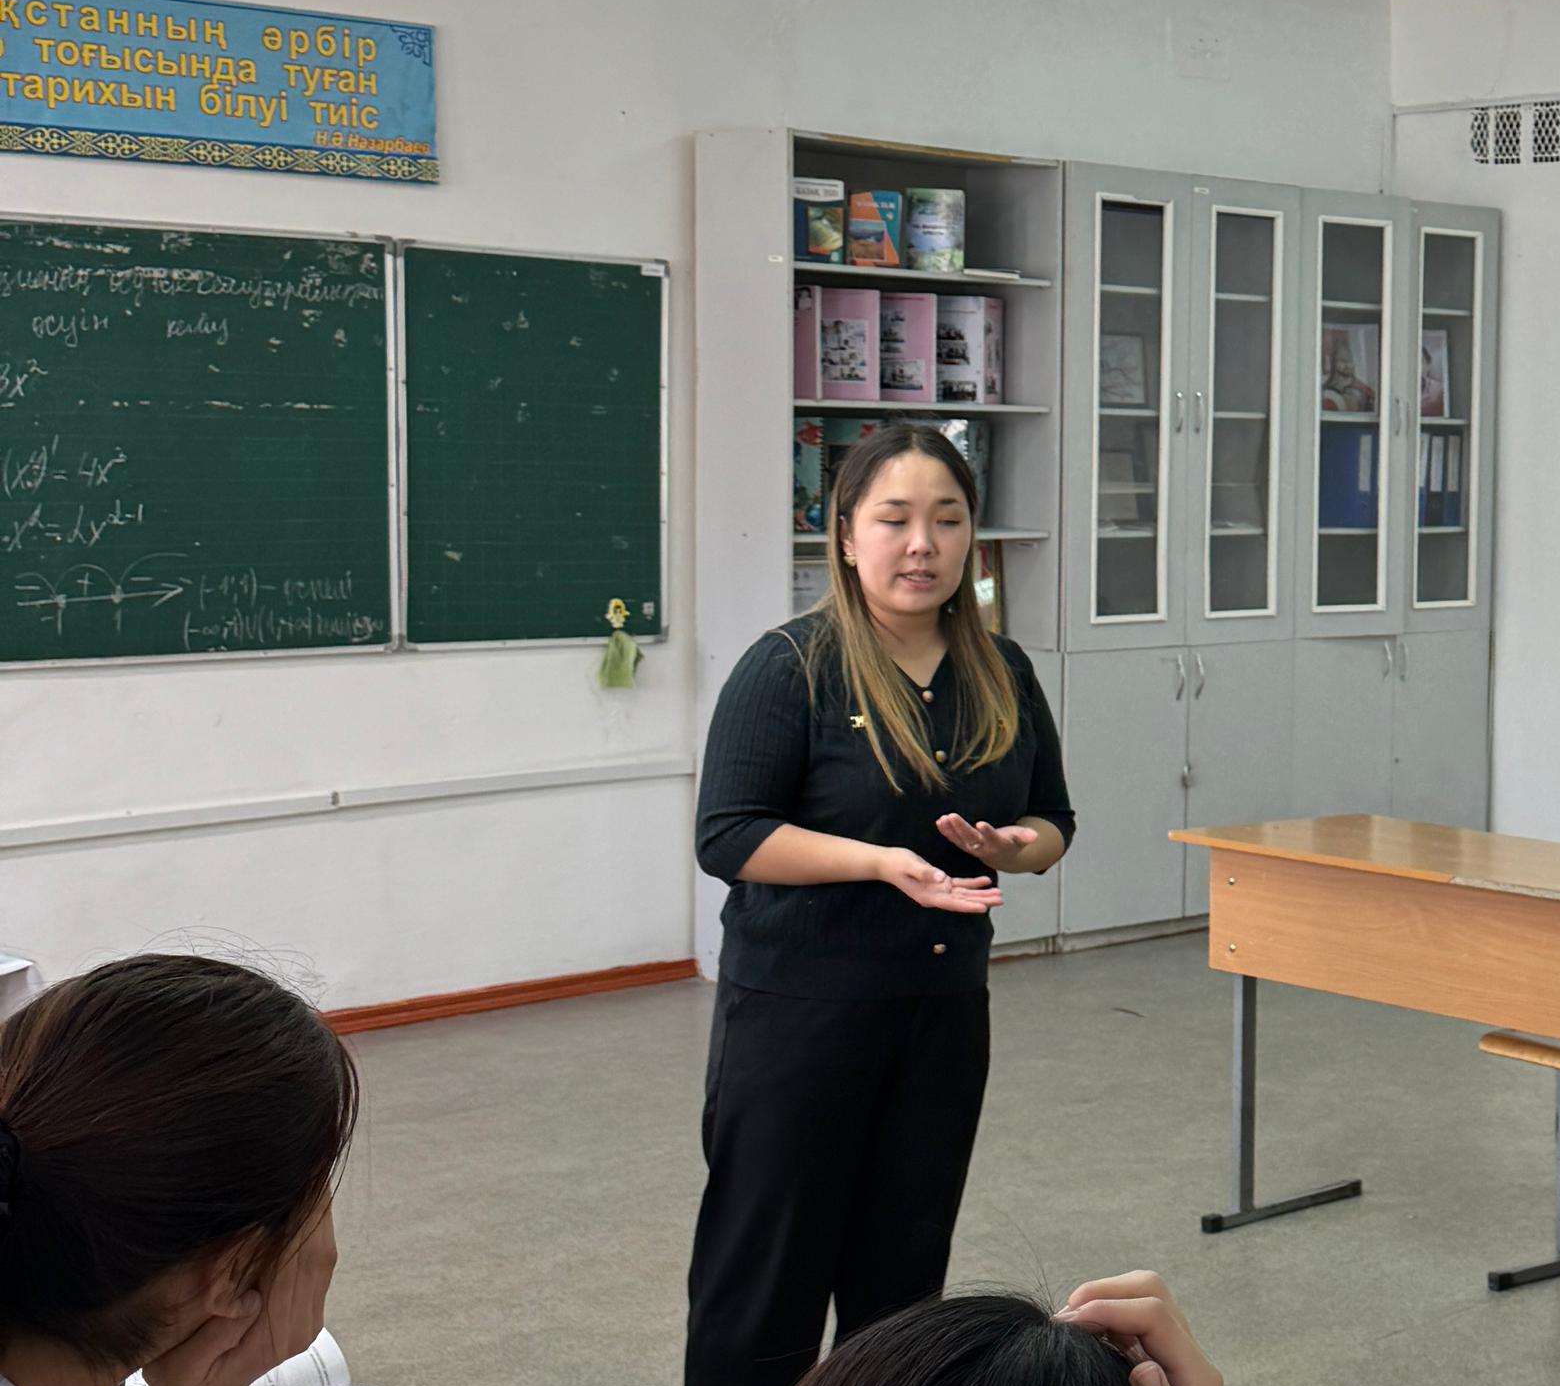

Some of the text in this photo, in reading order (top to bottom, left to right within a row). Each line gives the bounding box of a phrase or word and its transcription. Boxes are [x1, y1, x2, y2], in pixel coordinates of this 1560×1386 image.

[33, 38, 257, 86] тоғысында
[283, 64, 378, 97] туған
[262, 25, 377, 67] әрбір
[0, 72, 380, 130] тарихын білуі тиіс
